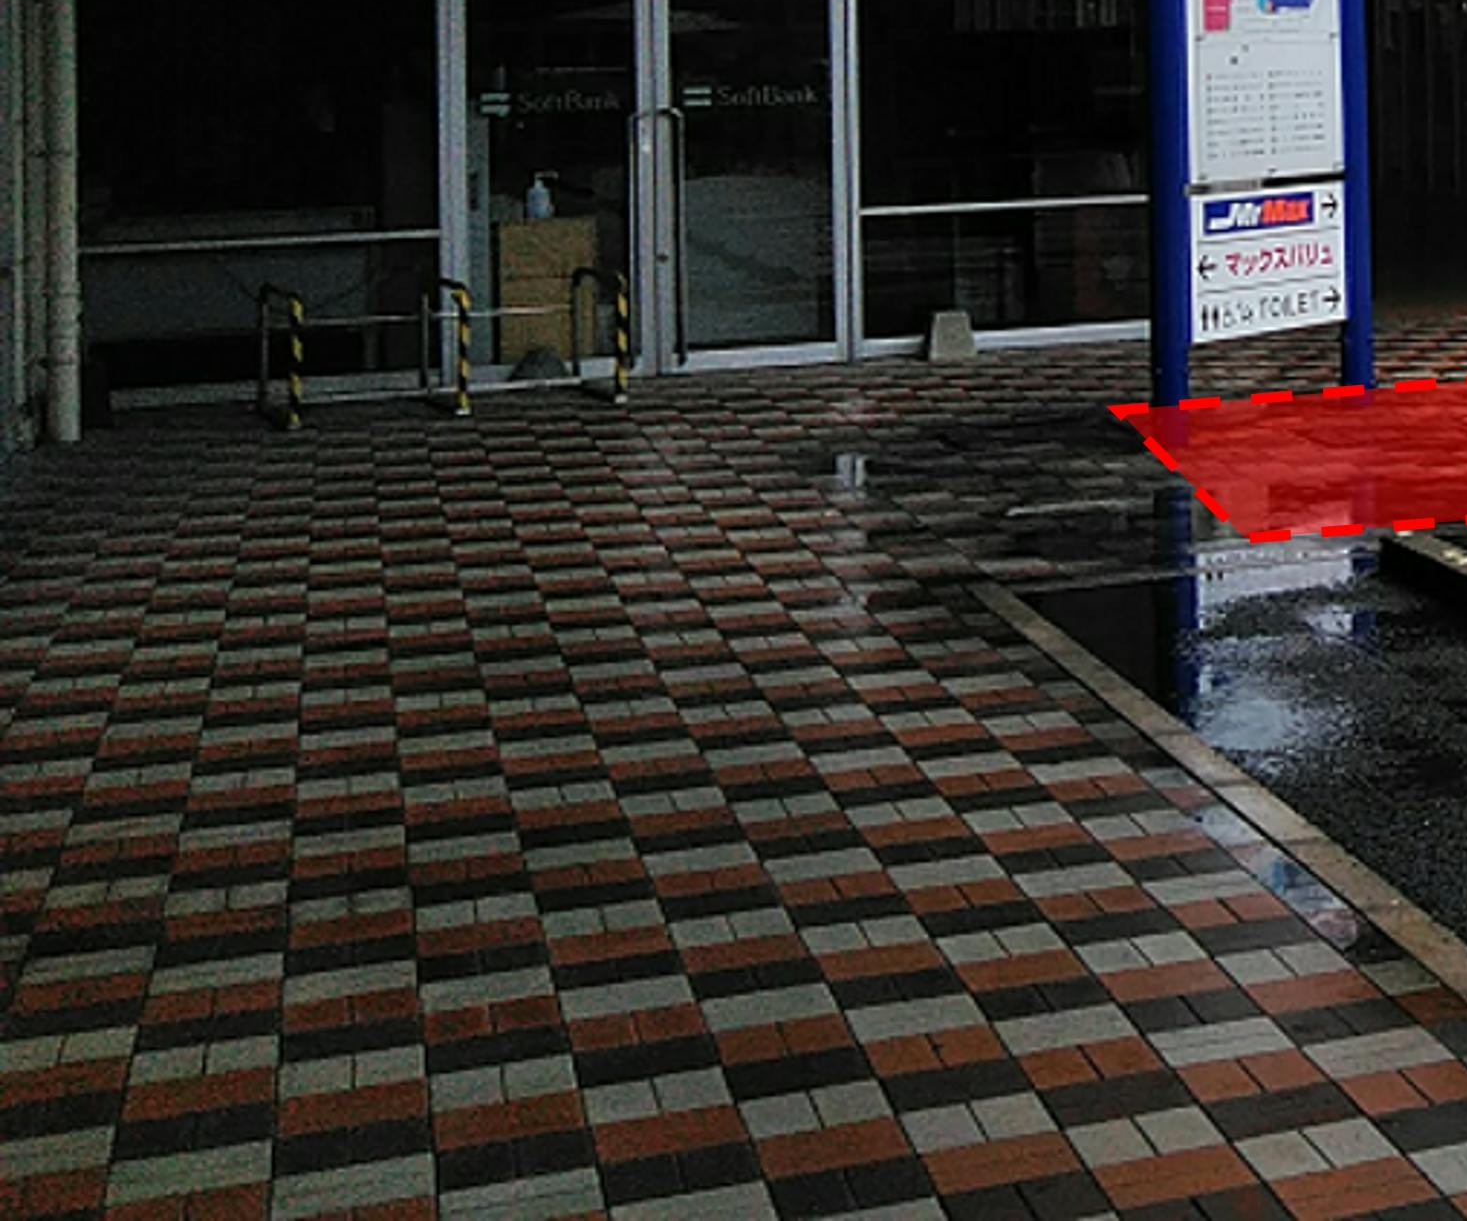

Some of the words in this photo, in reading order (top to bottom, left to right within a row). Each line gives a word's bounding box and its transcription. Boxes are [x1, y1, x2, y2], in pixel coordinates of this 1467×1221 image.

[517, 90, 622, 114] SoftBank
[716, 83, 819, 109] SoftBank
[1209, 198, 1311, 231] MrMax
[1224, 242, 1334, 277] マックスバリュ
[1259, 289, 1320, 319] TOILET
